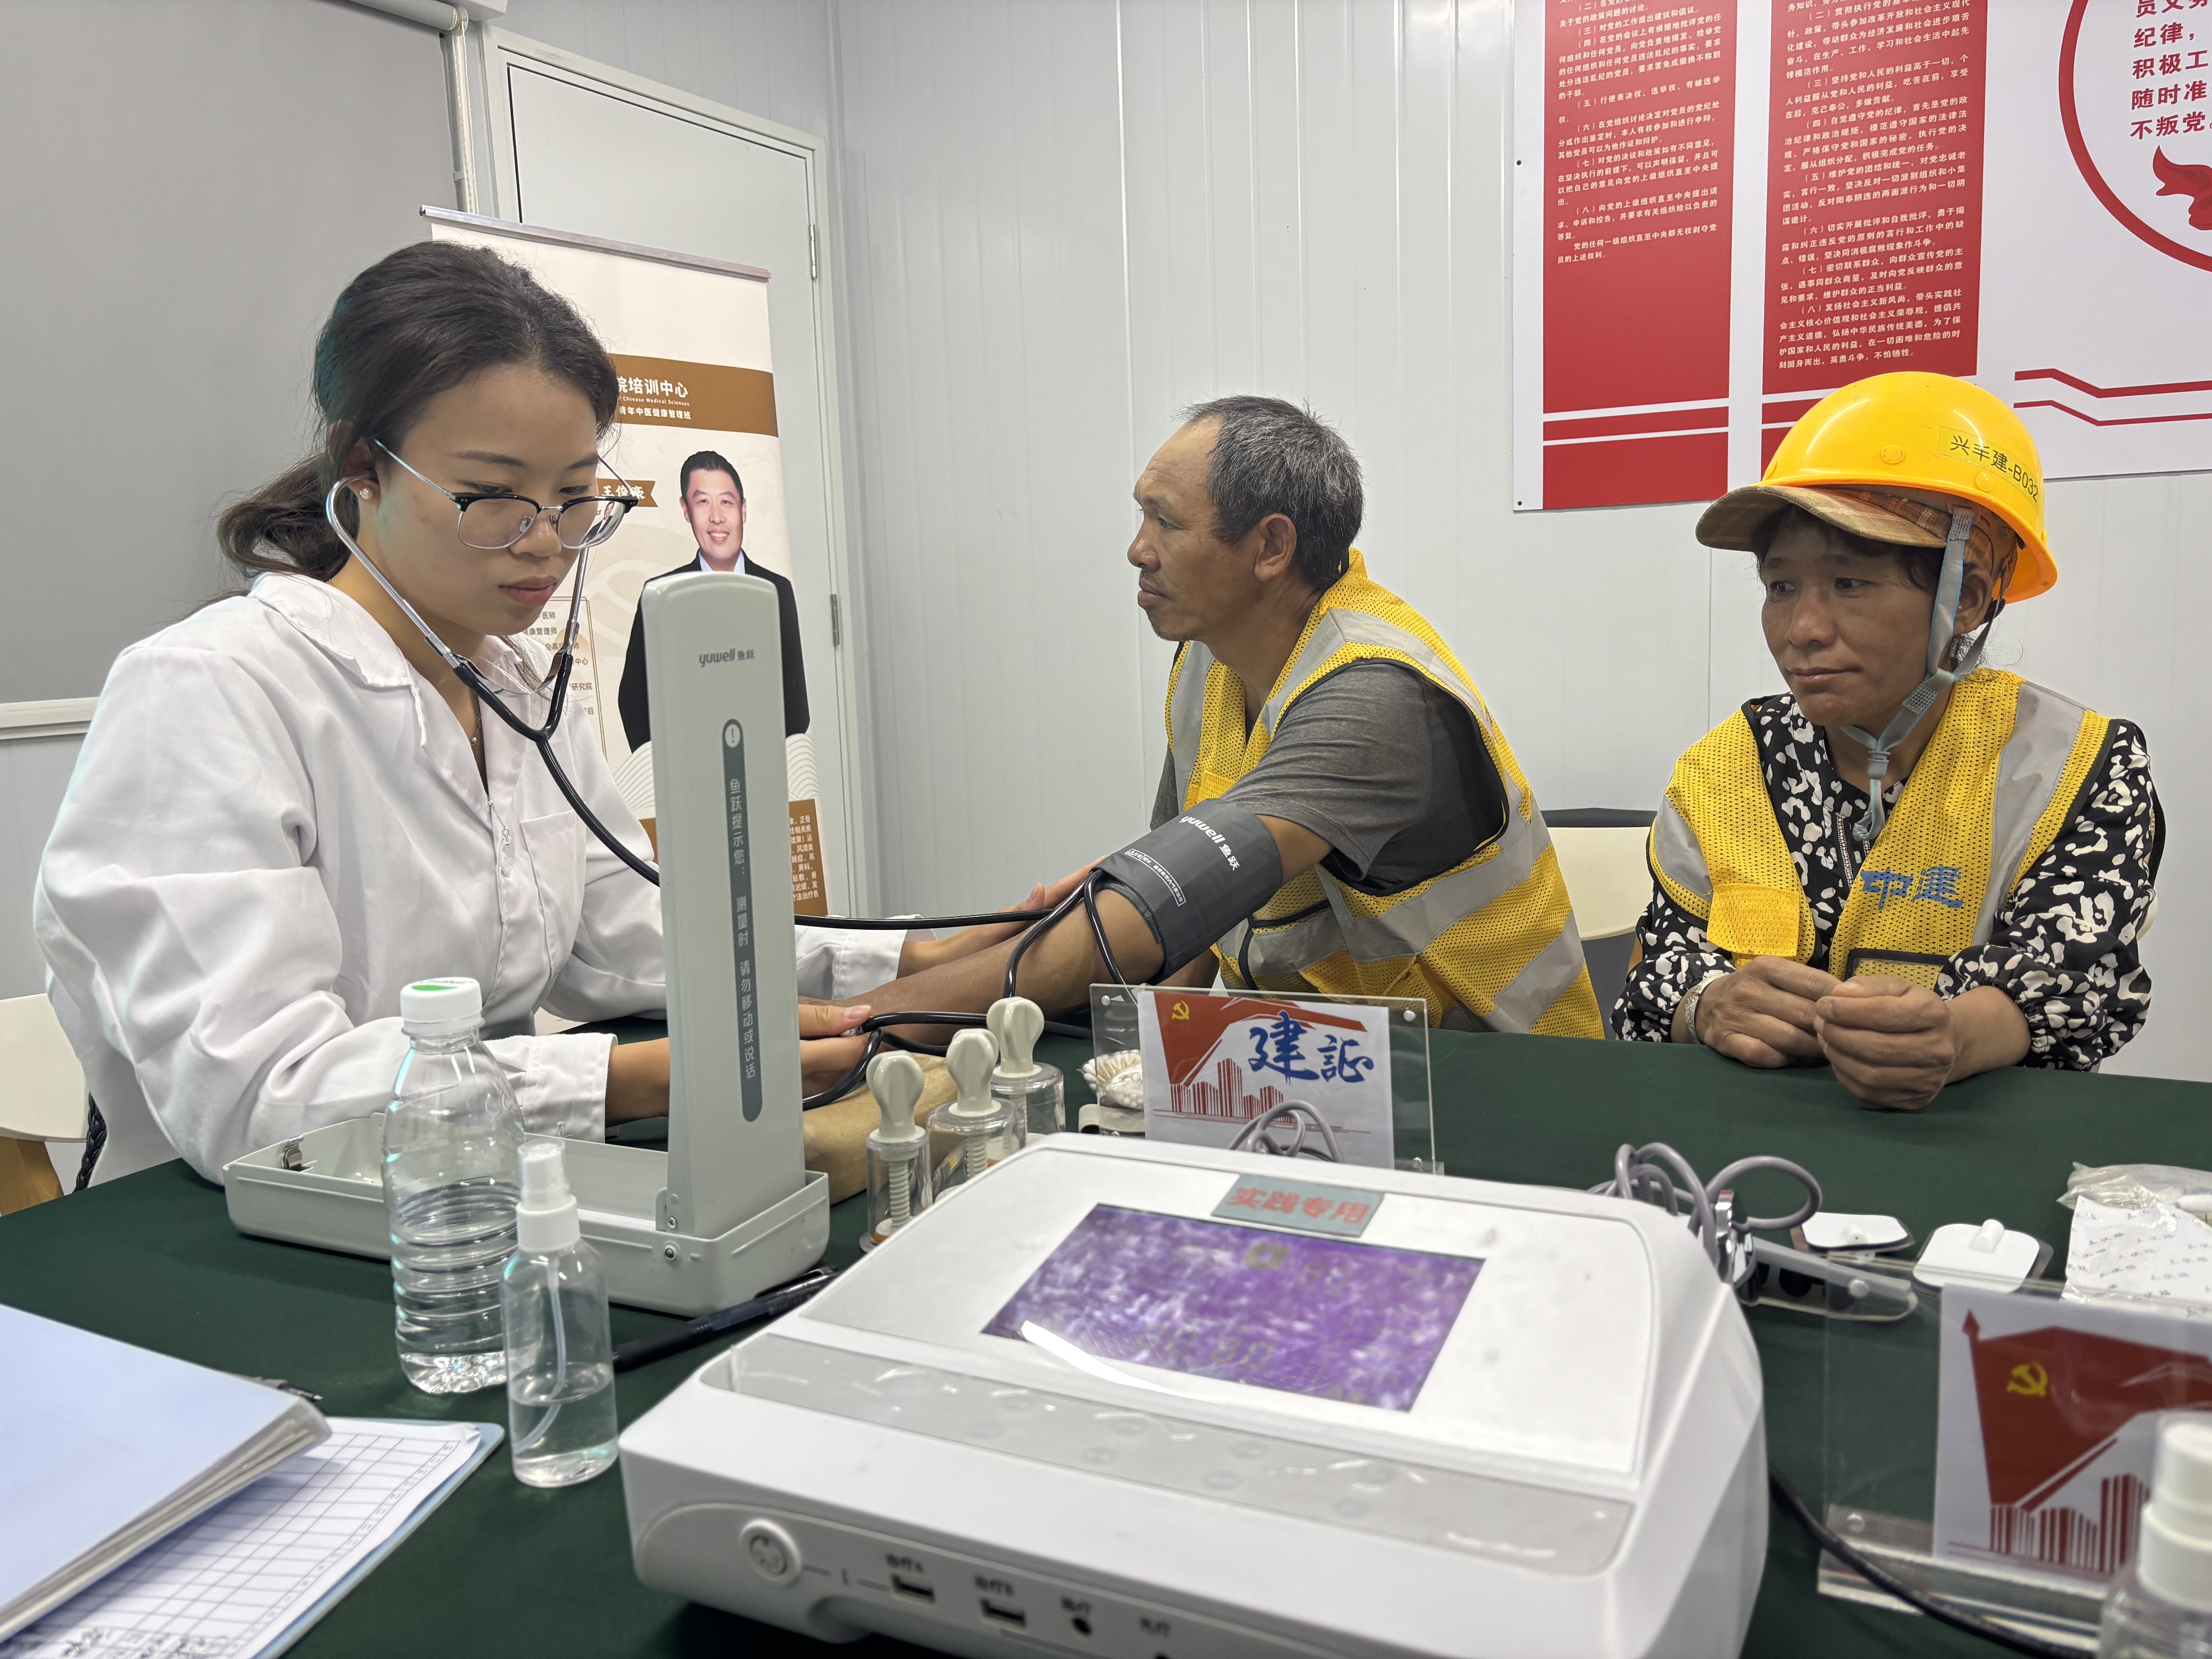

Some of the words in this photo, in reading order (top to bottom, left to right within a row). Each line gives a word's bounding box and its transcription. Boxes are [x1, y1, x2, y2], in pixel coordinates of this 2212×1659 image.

[2133, 22, 2194, 48] 纪律，
[2132, 50, 2209, 79] 积极工
[2131, 80, 2212, 110] 随时准
[699, 649, 735, 667] yuwell
[737, 649, 755, 661] 鱼跃
[570, 682, 593, 691] 研究院
[1179, 816, 1226, 844] yuwell
[1219, 843, 1240, 871] 鱼跃
[1860, 864, 1964, 911] 中建
[736, 895, 749, 947] 测量时
[740, 960, 756, 1079] 请勿移动或说话
[1226, 1185, 1371, 1224] 实践专用
